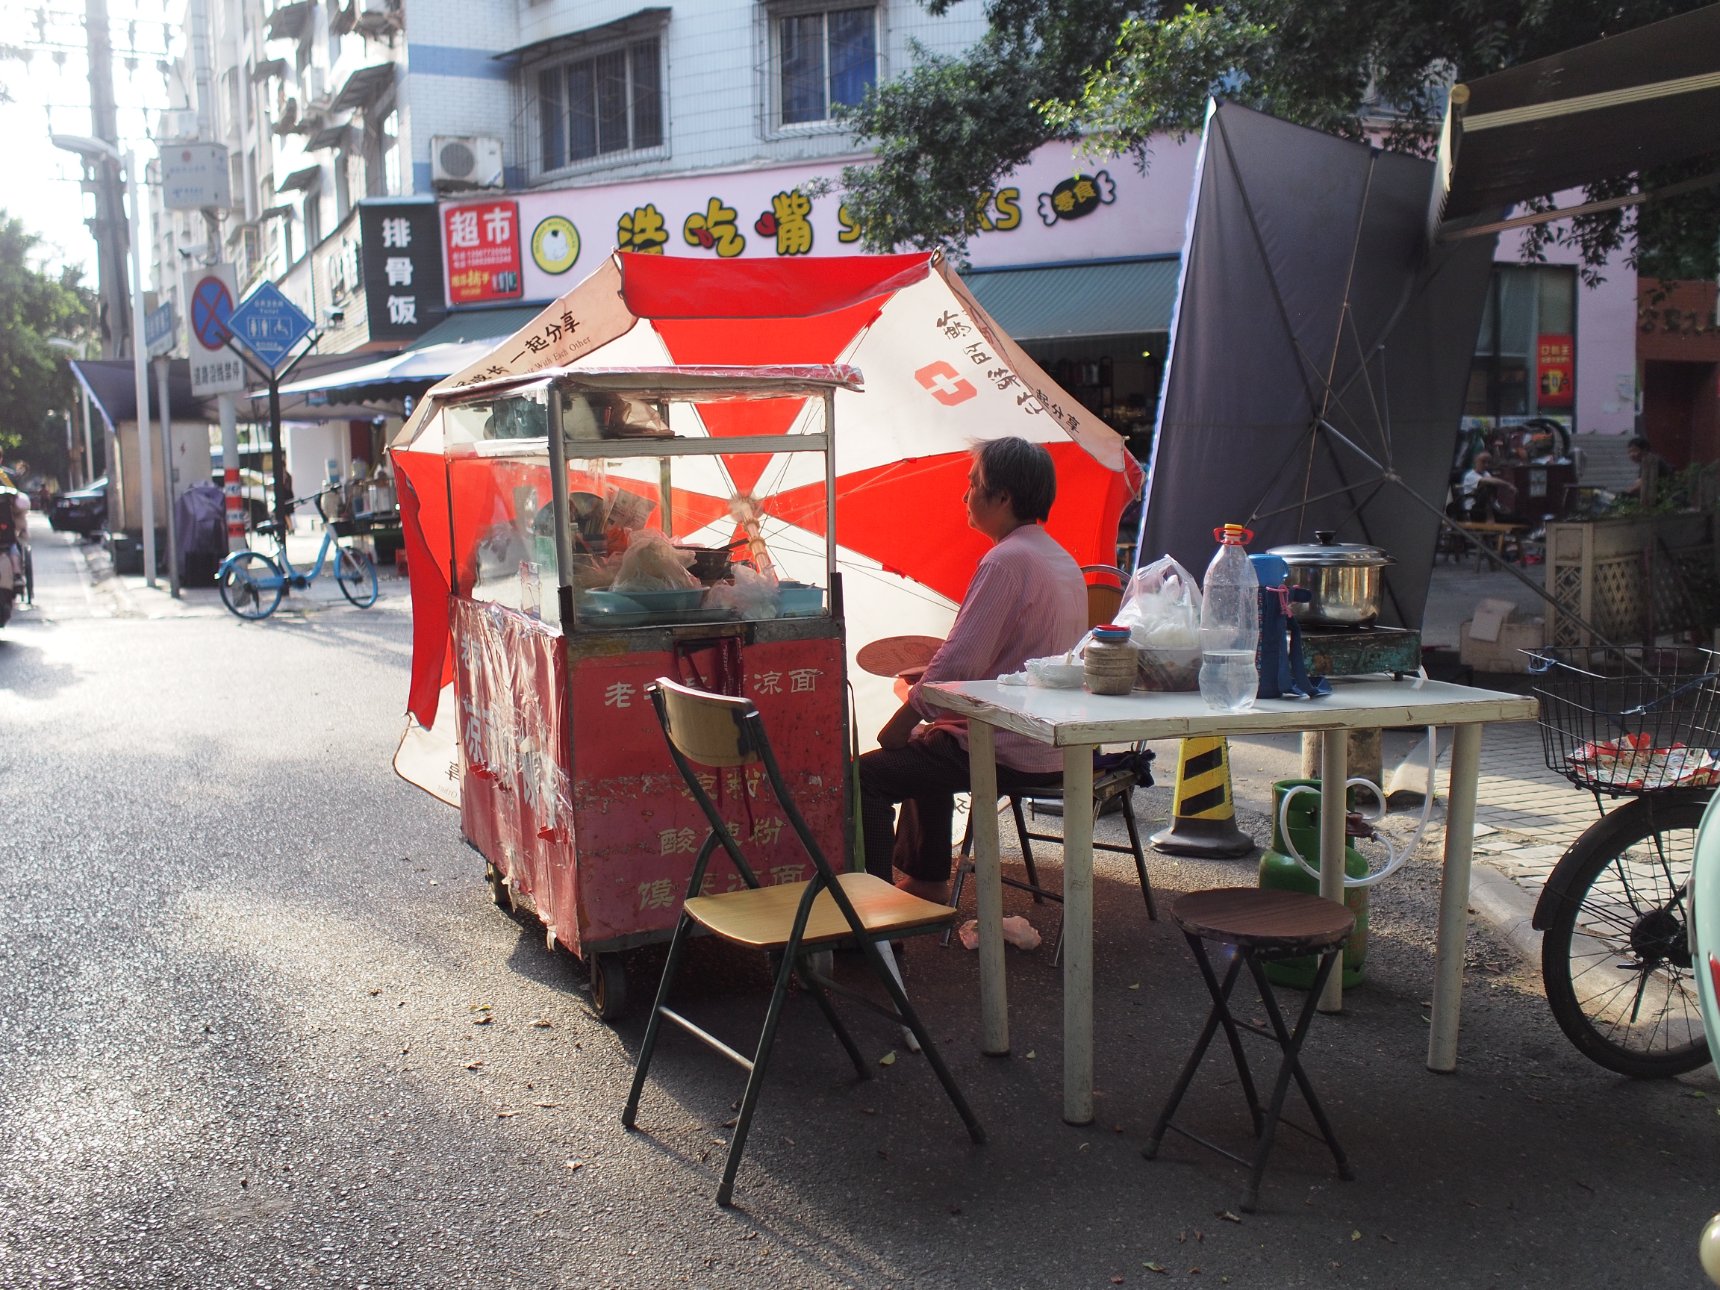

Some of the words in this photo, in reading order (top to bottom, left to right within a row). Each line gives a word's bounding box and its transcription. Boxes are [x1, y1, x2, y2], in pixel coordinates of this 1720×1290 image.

[450, 206, 513, 248] 超市
[838, 187, 1021, 243] SKS
[382, 217, 417, 325] 排骨饭
[510, 310, 580, 364] 一起分享
[569, 336, 591, 352] Other
[604, 668, 823, 708] 老凉面
